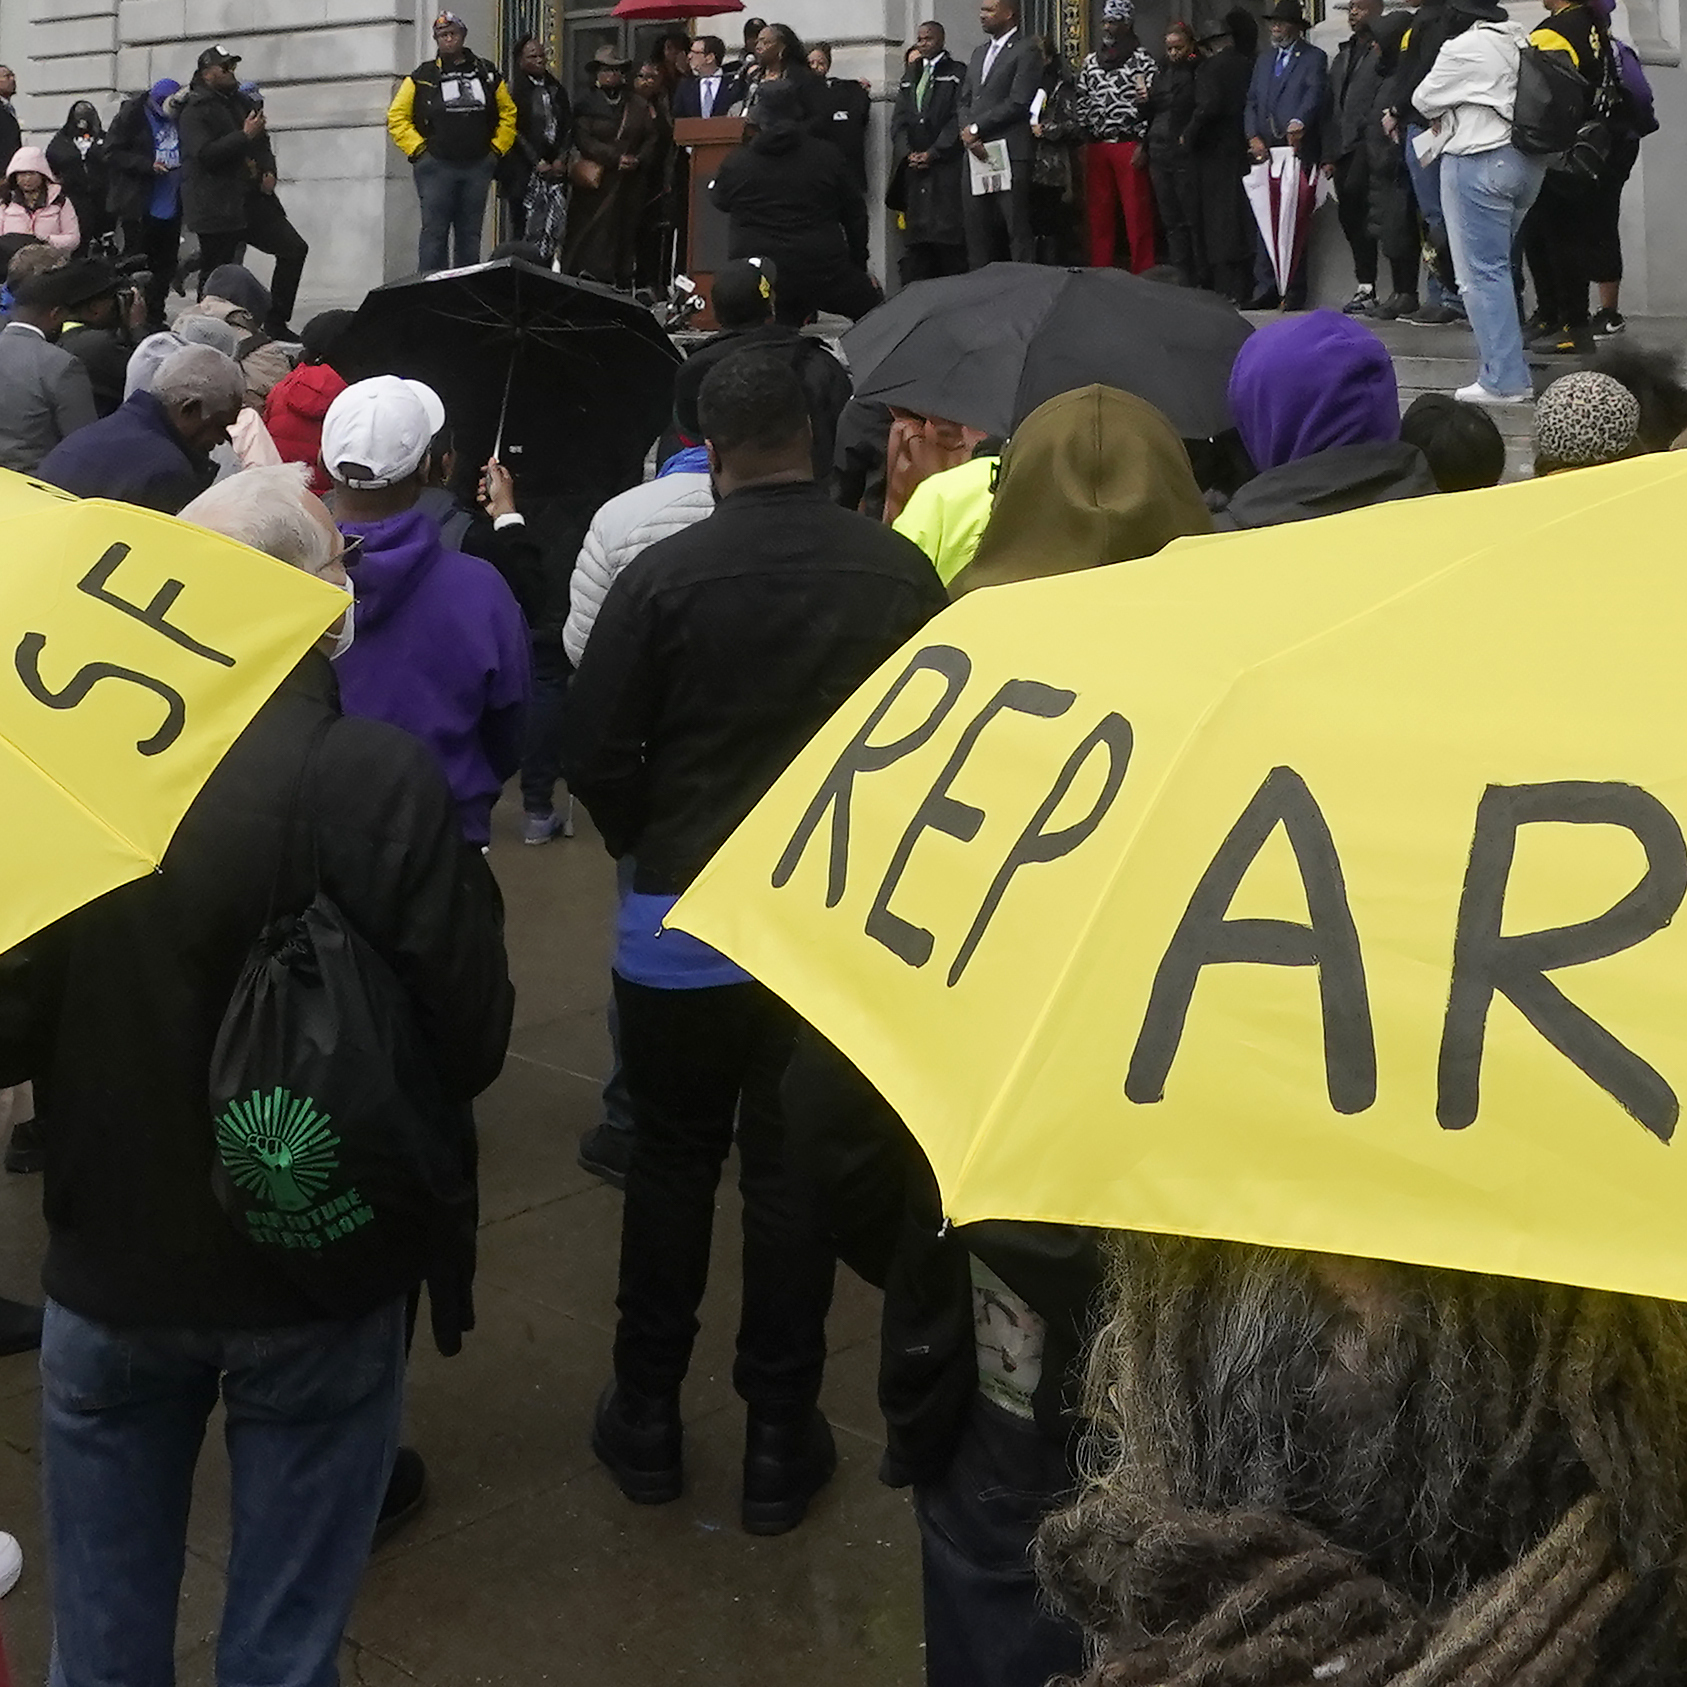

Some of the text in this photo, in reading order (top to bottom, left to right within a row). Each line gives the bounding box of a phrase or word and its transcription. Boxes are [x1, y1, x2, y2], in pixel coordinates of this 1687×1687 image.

[14, 541, 238, 757] SF
[285, 1187, 361, 1230] FUTURE
[324, 1205, 374, 1241] NOW
